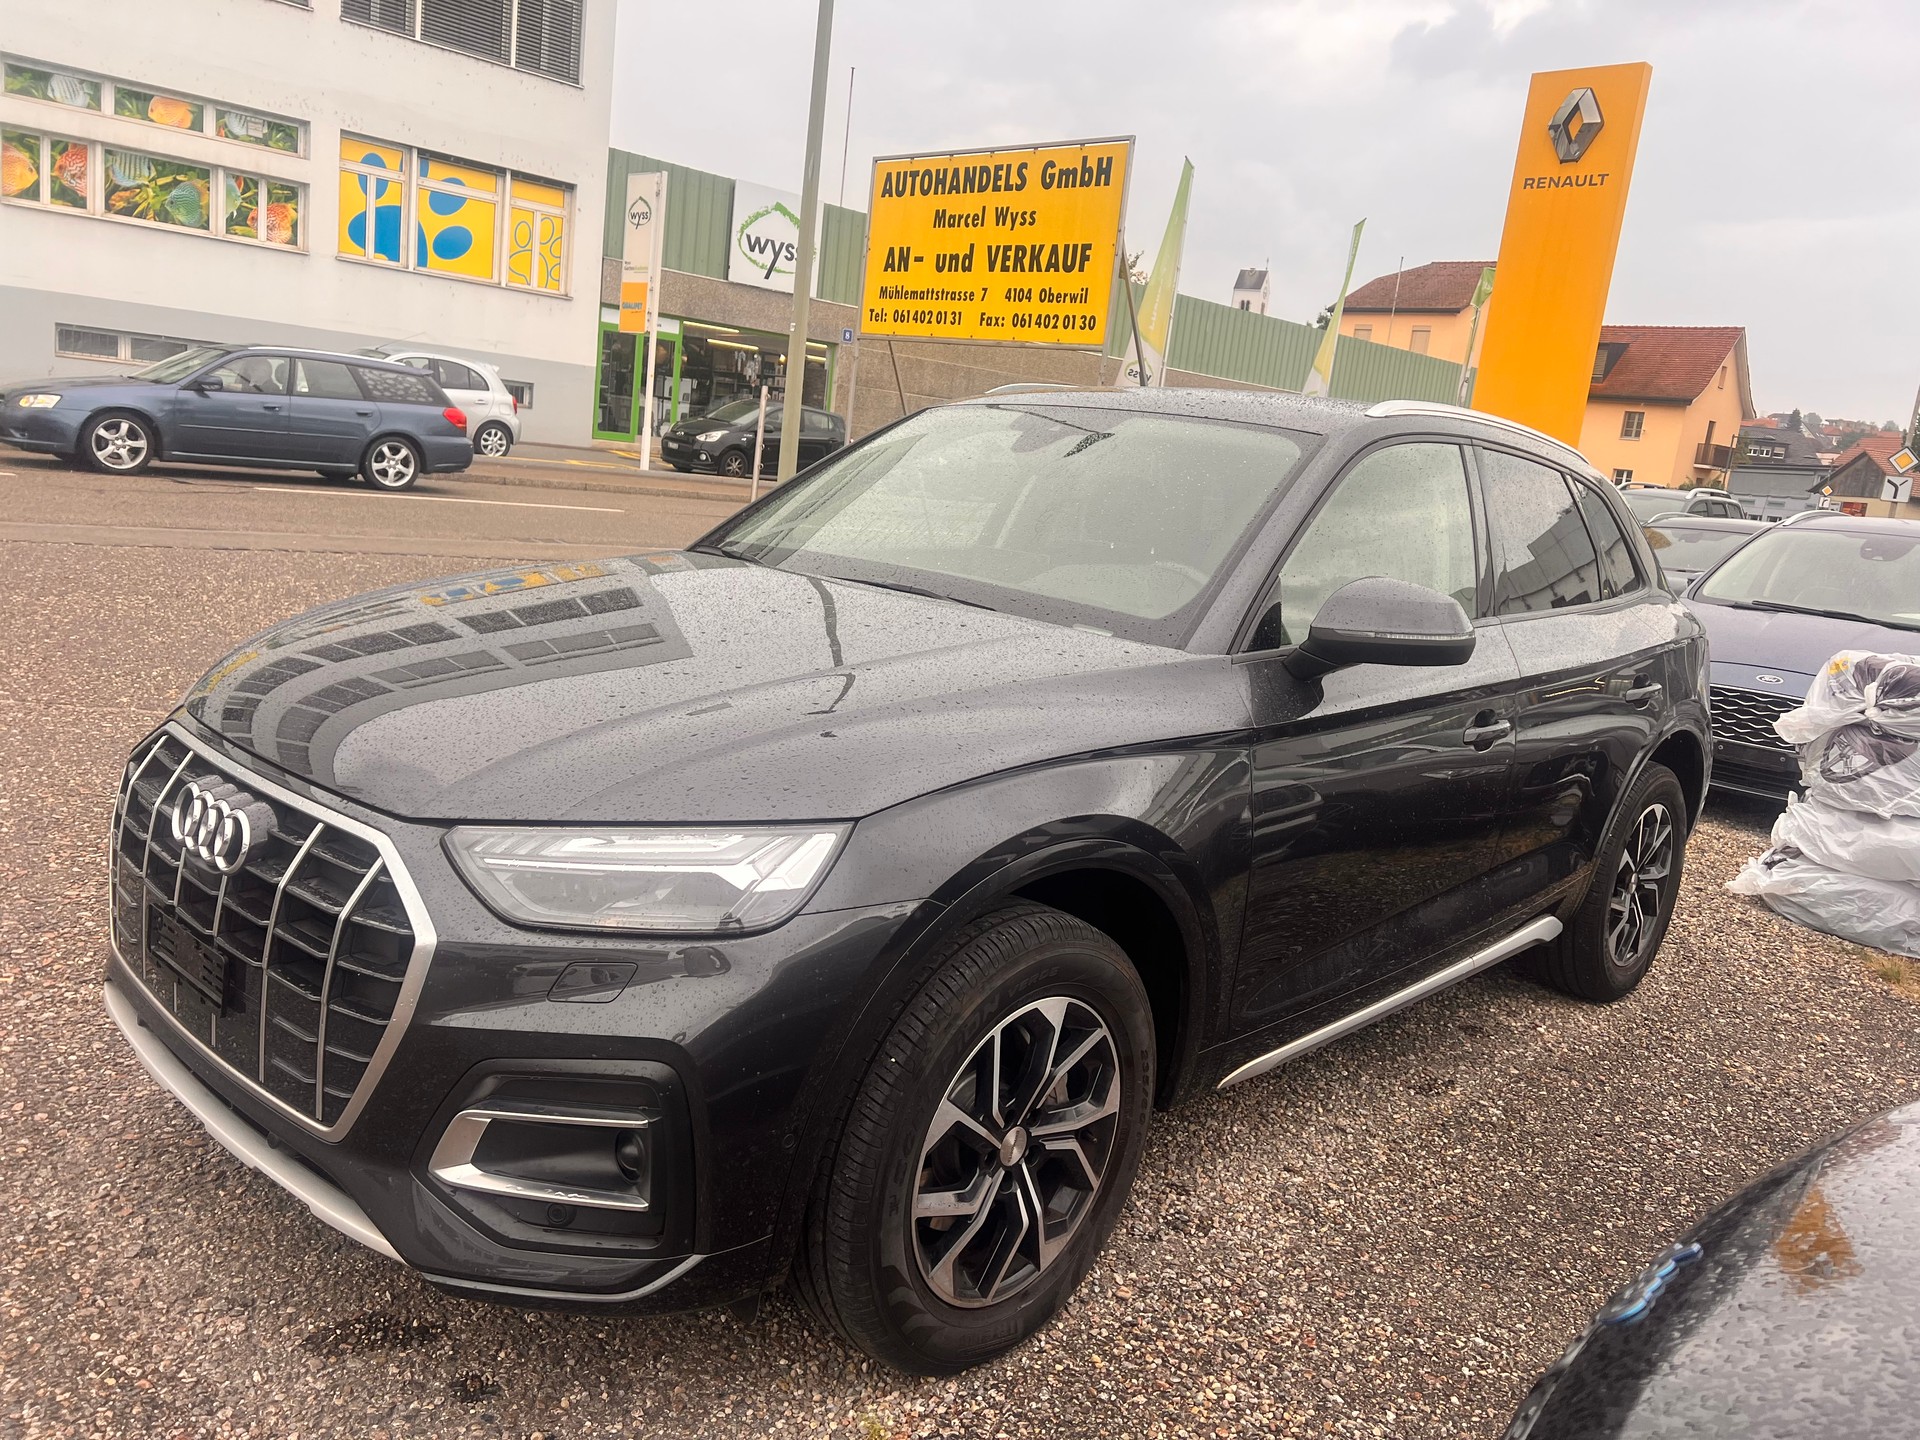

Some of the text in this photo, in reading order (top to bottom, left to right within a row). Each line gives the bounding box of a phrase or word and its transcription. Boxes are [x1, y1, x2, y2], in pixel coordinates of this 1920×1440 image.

[881, 155, 1113, 198] AUTOHANDELS GmbH
[1523, 173, 1610, 190] RENAULT
[630, 211, 649, 230] wyss
[933, 205, 1037, 231] Marcel Wyss
[883, 243, 1092, 273] AN- und VERKAUF
[879, 285, 1089, 304] Mühlemattstrasse 7 4104 Oberwil
[869, 308, 887, 323] Tel:
[979, 311, 1005, 328] Fax:
